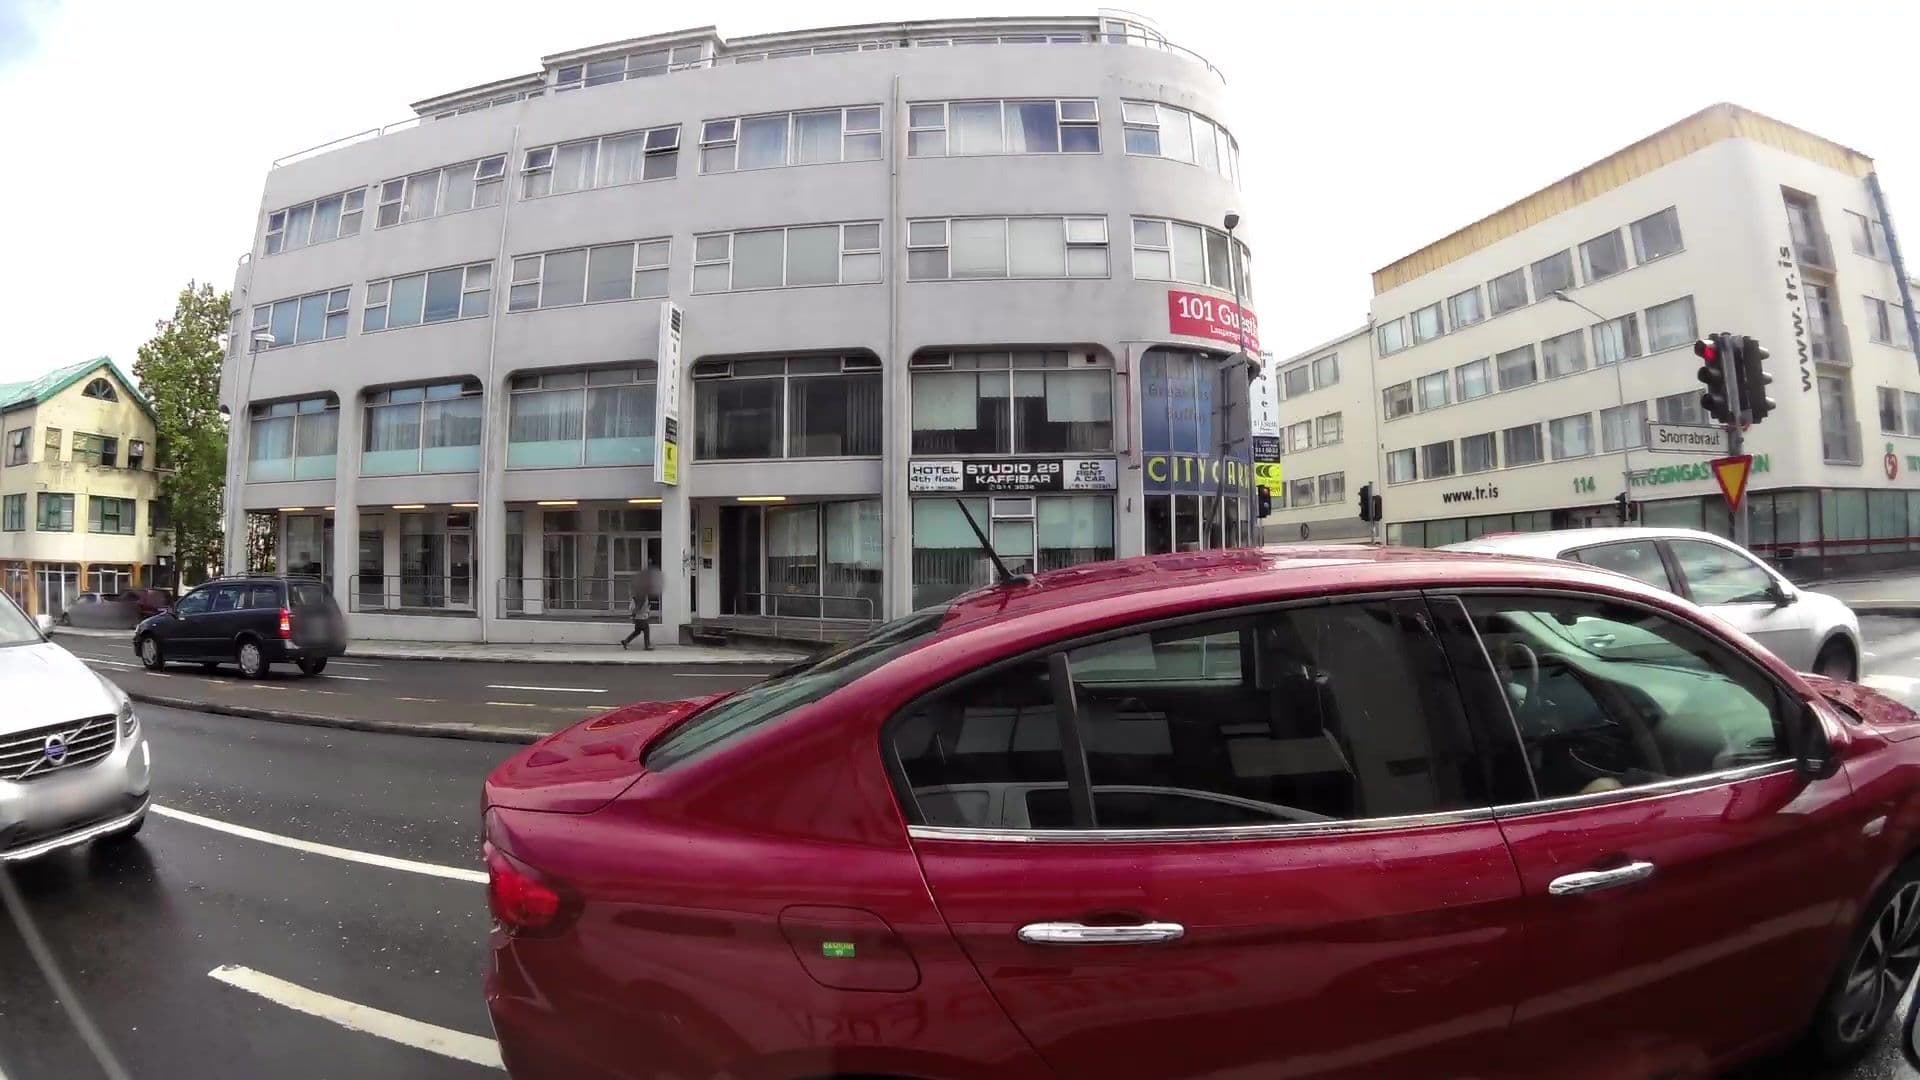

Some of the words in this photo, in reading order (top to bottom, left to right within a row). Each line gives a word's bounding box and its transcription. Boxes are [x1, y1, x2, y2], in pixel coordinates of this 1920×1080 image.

[1178, 296, 1215, 322] 101
[1779, 246, 1812, 393] www.tr.is
[1659, 428, 1720, 446] Snorrabraut
[912, 466, 960, 475] HOTEL
[966, 463, 1031, 474] STUDIO
[1037, 463, 1060, 474] 29
[1080, 462, 1100, 470] CC
[911, 475, 931, 483] 4th
[935, 475, 961, 483] floor
[975, 474, 1051, 484] KAFFIBAR
[1573, 476, 1596, 494] 114
[1442, 482, 1499, 504] www.tr.is
